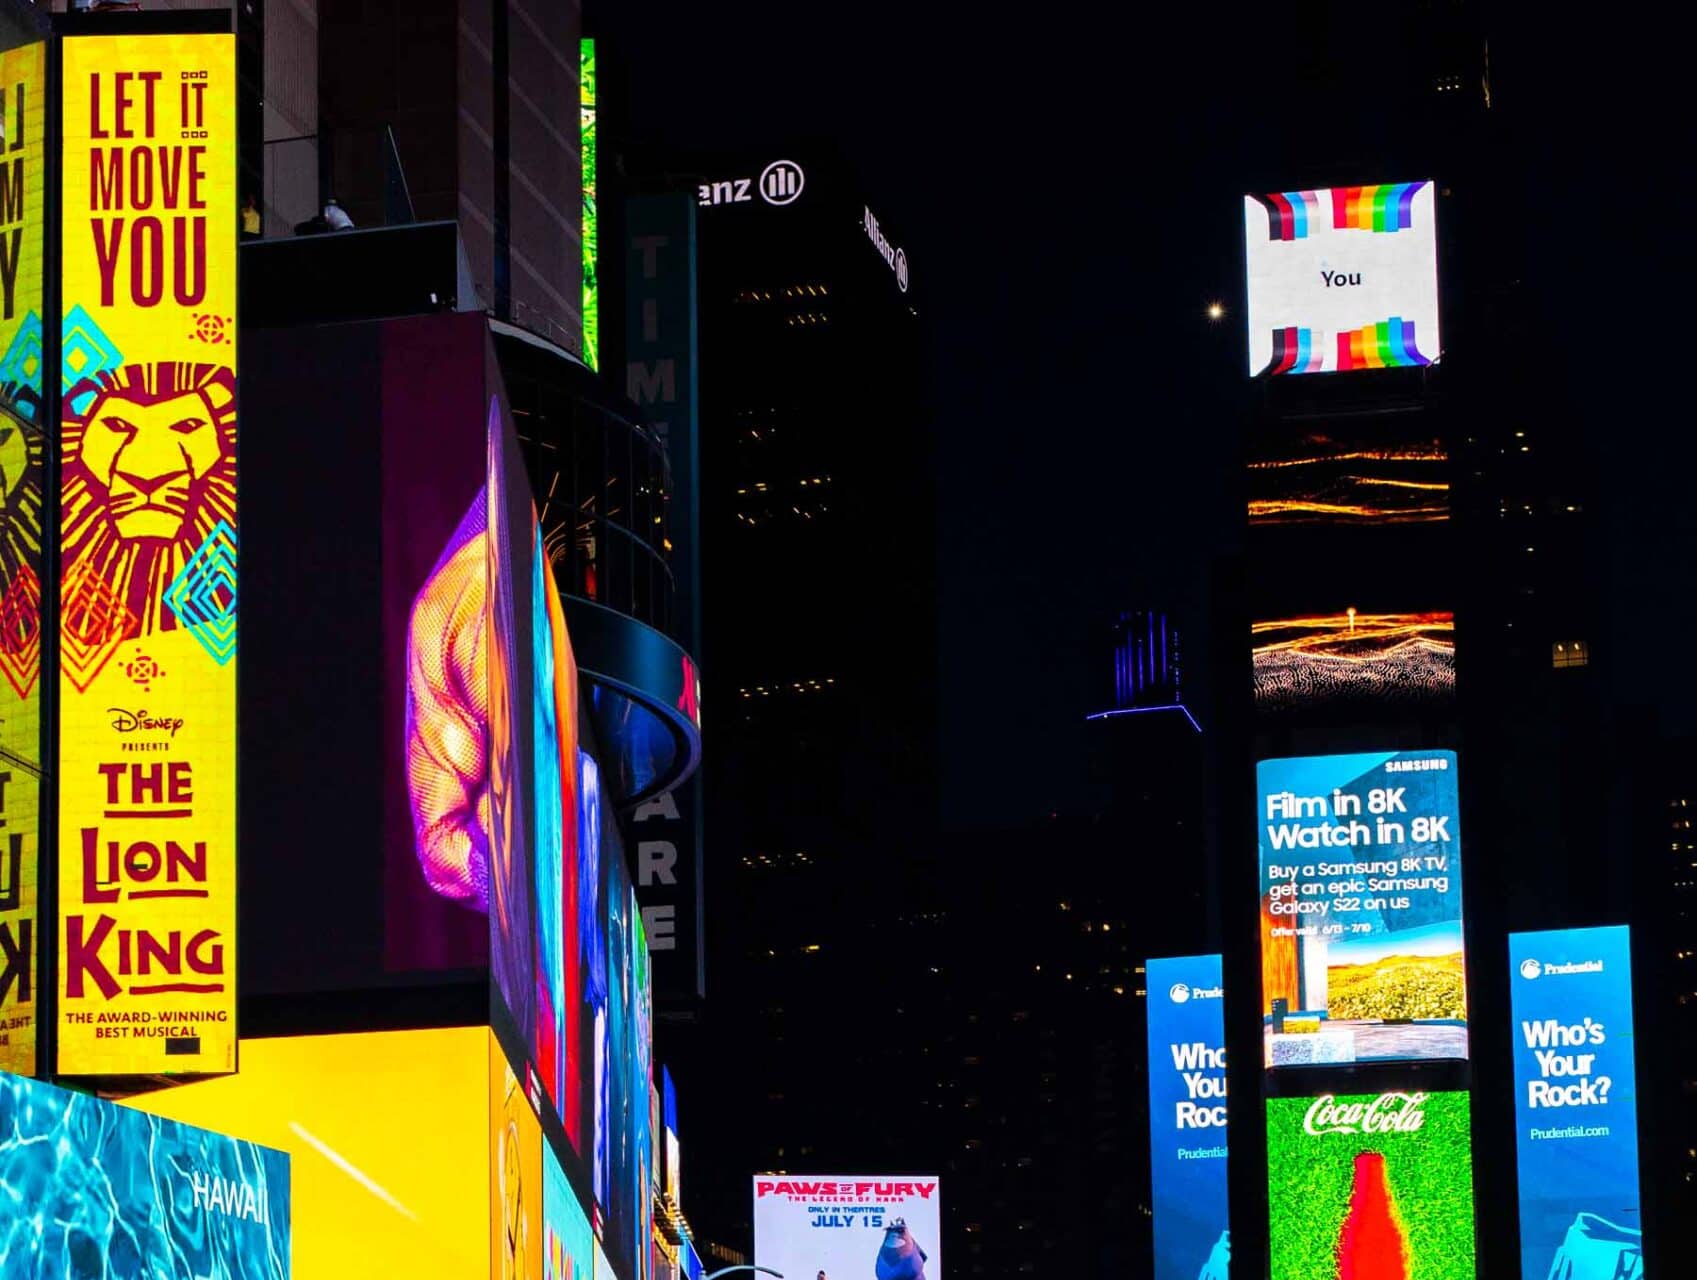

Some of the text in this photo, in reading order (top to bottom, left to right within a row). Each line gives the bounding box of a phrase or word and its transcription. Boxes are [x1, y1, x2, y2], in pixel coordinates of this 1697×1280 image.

[90, 72, 208, 138] LET IT
[90, 145, 207, 211] MOVE
[864, 204, 895, 271] Allianz
[90, 216, 207, 308] YOU
[1321, 270, 1361, 287] You
[122, 743, 169, 751] PRESENTS
[1385, 759, 1448, 773] SAMSUNG
[98, 762, 194, 804] THE
[1266, 787, 1407, 820] Film in 8K
[1267, 815, 1451, 850] Watch in 8K
[81, 827, 206, 903] LION
[1269, 864, 1299, 881] Buy
[1303, 866, 1314, 877] a
[1318, 860, 1397, 877] Samsung
[1401, 857, 1421, 872] 8K
[1269, 875, 1448, 900] get an epic Samsung
[1269, 896, 1410, 916] Galaxy S22 on us
[66, 914, 225, 1000] KING
[1544, 959, 1603, 975] Prudential
[66, 1011, 228, 1024] THE AWARD-WINNING
[96, 1026, 197, 1039] BEST MUSICAL
[1522, 1018, 1606, 1049] Who's
[1535, 1050, 1595, 1078] Your
[1528, 1076, 1612, 1108] Rock?
[1530, 1125, 1610, 1140] Prudential.com
[193, 1171, 267, 1225] HAWAII
[757, 1182, 837, 1198] PAWS
[855, 1183, 936, 1199] FURY
[811, 1215, 883, 1227] JULY 15
